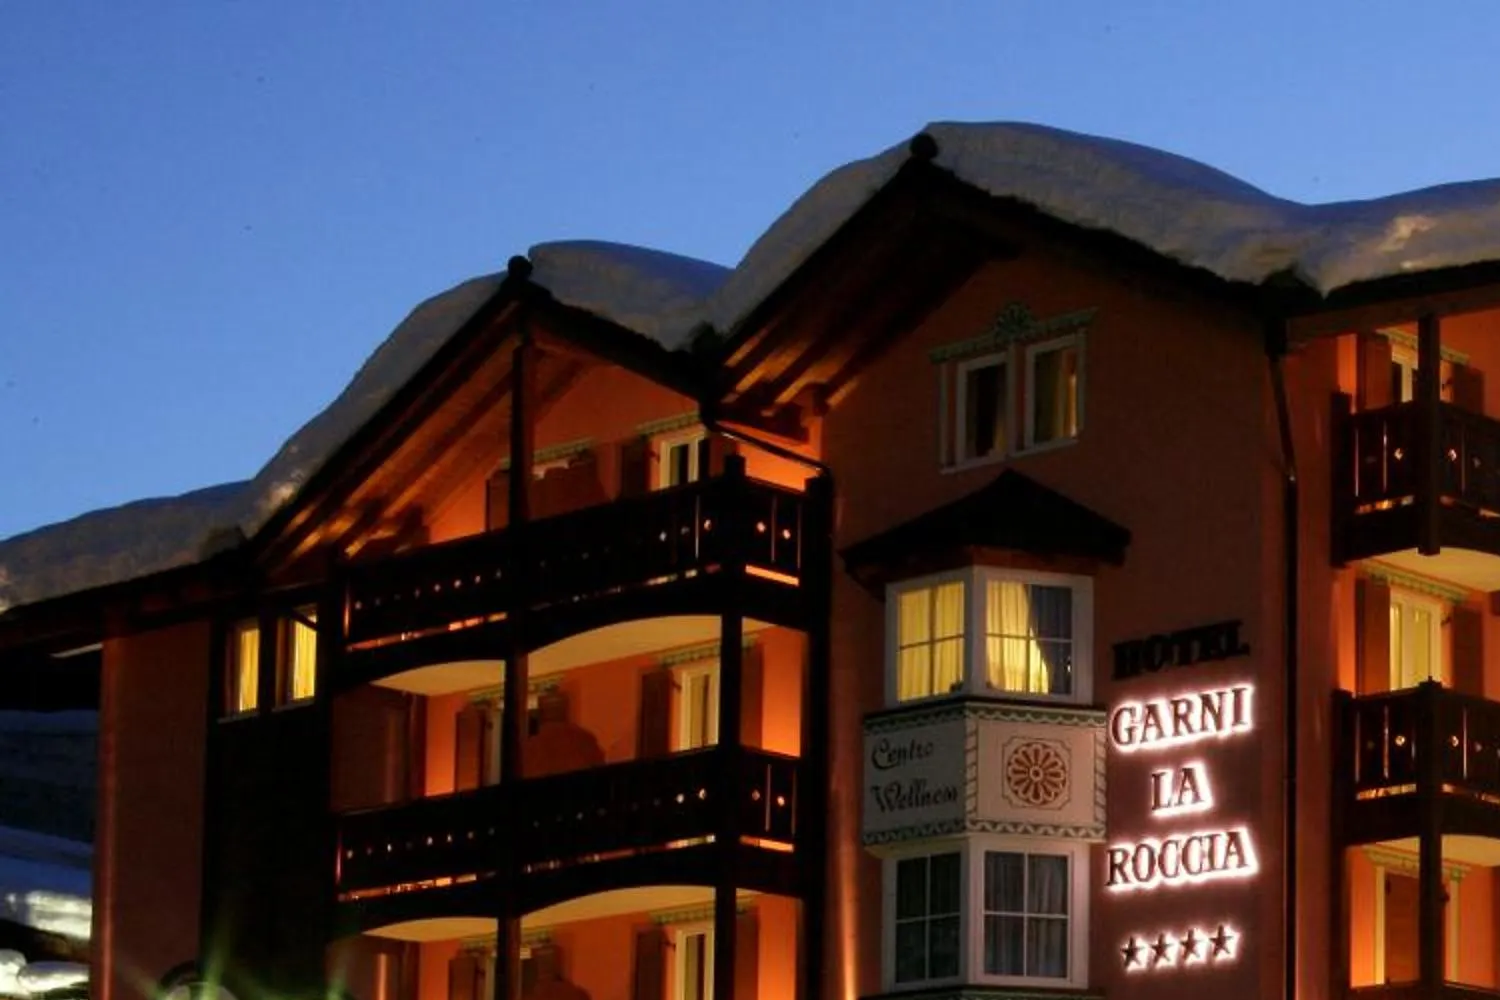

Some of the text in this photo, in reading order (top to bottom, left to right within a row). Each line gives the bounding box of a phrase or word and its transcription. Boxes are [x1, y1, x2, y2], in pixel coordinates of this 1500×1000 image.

[1111, 619, 1251, 682] HOTEL
[1110, 685, 1250, 746] GARNI
[871, 738, 934, 770] Centro
[1151, 766, 1205, 811] LA
[1105, 830, 1251, 887] ROCCIA
